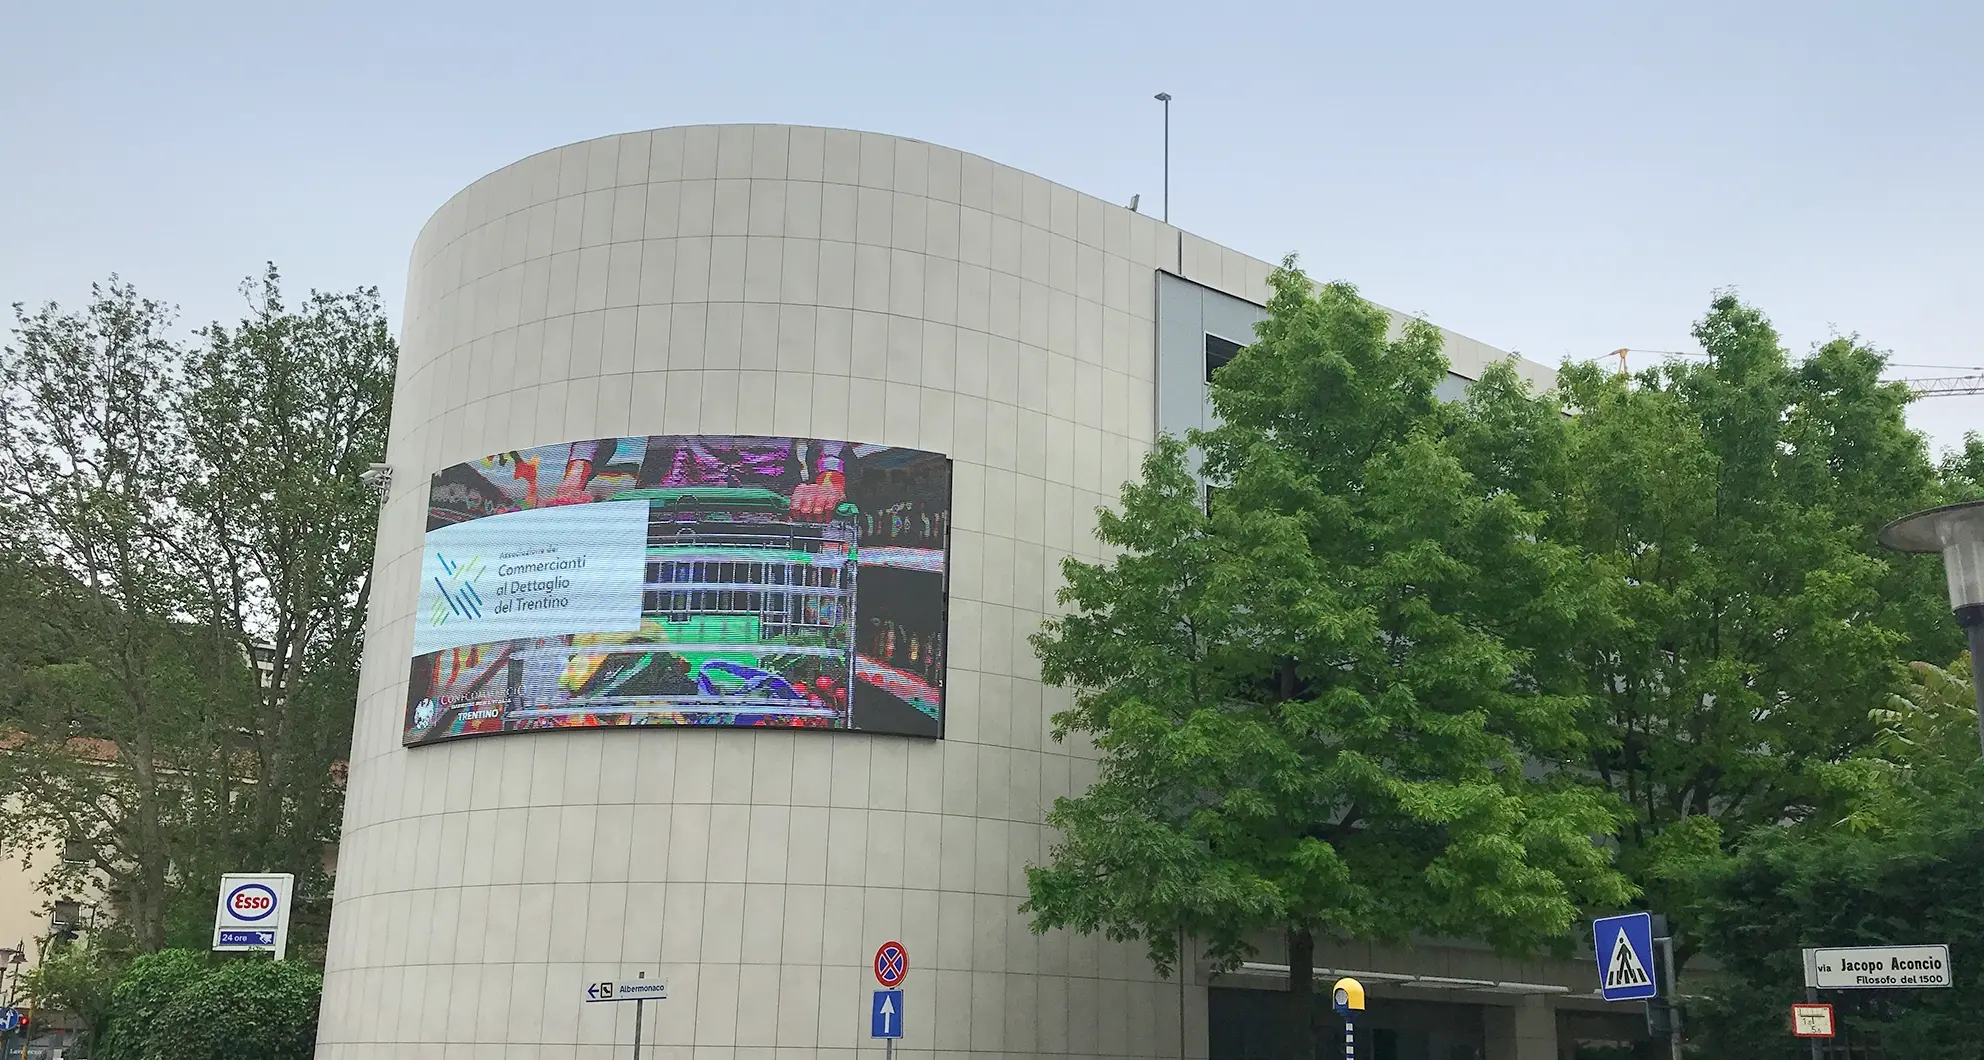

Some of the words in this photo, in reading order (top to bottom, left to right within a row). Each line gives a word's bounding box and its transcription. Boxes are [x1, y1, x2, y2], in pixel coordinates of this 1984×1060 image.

[498, 554, 586, 577] Commercianti
[496, 581, 508, 596] al
[510, 575, 570, 594] Dettaglio
[494, 599, 513, 615] del
[515, 594, 569, 612] Trentino
[458, 709, 499, 721] TRENTINO
[234, 893, 270, 909] Esso
[221, 933, 234, 942] 24
[234, 934, 248, 942] ore
[1817, 964, 1832, 972] via
[1841, 958, 1884, 974] Jacopo
[1891, 956, 1942, 971] Aconcio
[1856, 975, 1897, 984] Filosofo
[1900, 975, 1917, 984] del
[1919, 975, 1943, 983] 1500
[619, 984, 665, 993] Albermonaco
